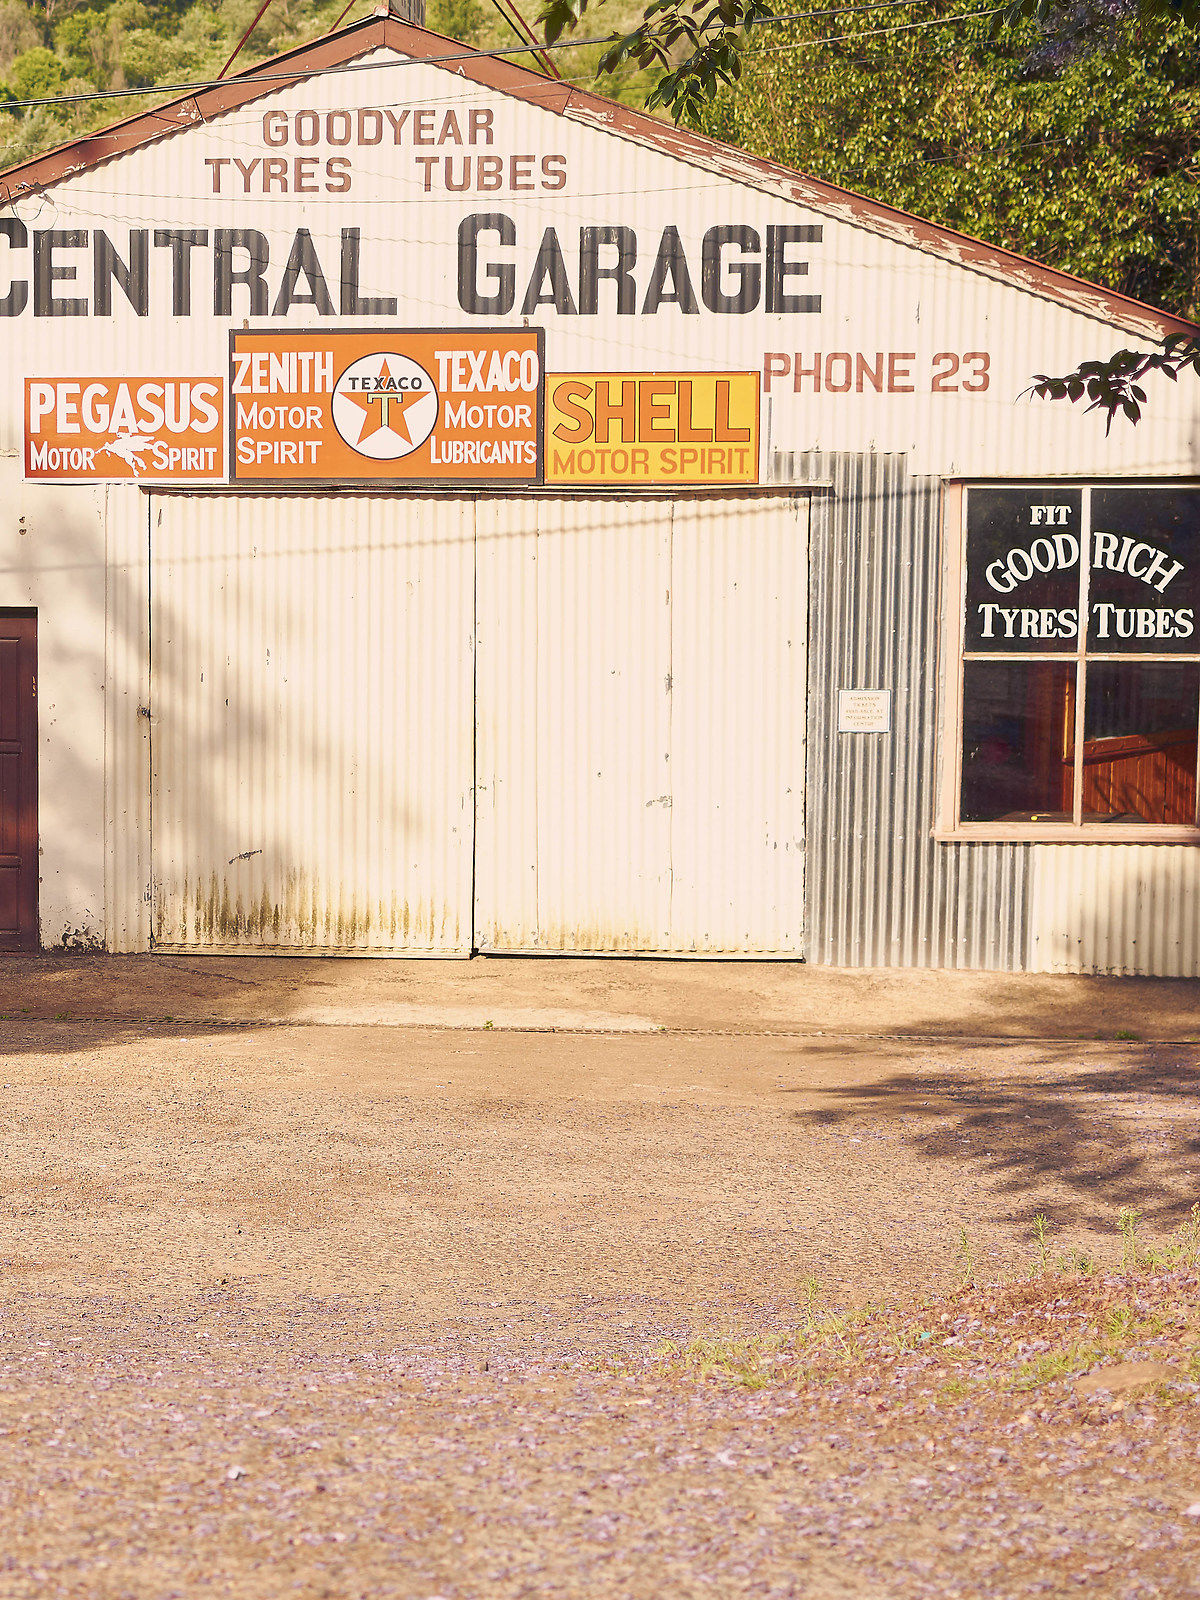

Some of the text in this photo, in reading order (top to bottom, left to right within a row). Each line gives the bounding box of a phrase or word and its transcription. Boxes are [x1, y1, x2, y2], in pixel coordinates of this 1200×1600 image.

[262, 109, 494, 147] GOODYEAR
[204, 155, 567, 193] TYRES TUBES
[457, 212, 823, 316] GARAGE
[231, 351, 334, 394] ZENITH
[348, 376, 423, 390] TEXACO
[434, 350, 540, 392] TEXACO
[763, 351, 991, 393] PHONE 23
[30, 382, 220, 434] PEGASUS
[237, 401, 323, 430] MOTOR
[444, 400, 532, 429] MOTOR
[552, 380, 751, 444] SHELL
[30, 440, 96, 471] MOTOR
[152, 440, 218, 471] SPIRIT
[237, 437, 323, 465] SPIRIT
[430, 435, 537, 465] LUBRICANTS
[553, 449, 649, 475] MOTOR
[1029, 505, 1072, 526] FIT
[978, 603, 1195, 638] TYRES TUBES
